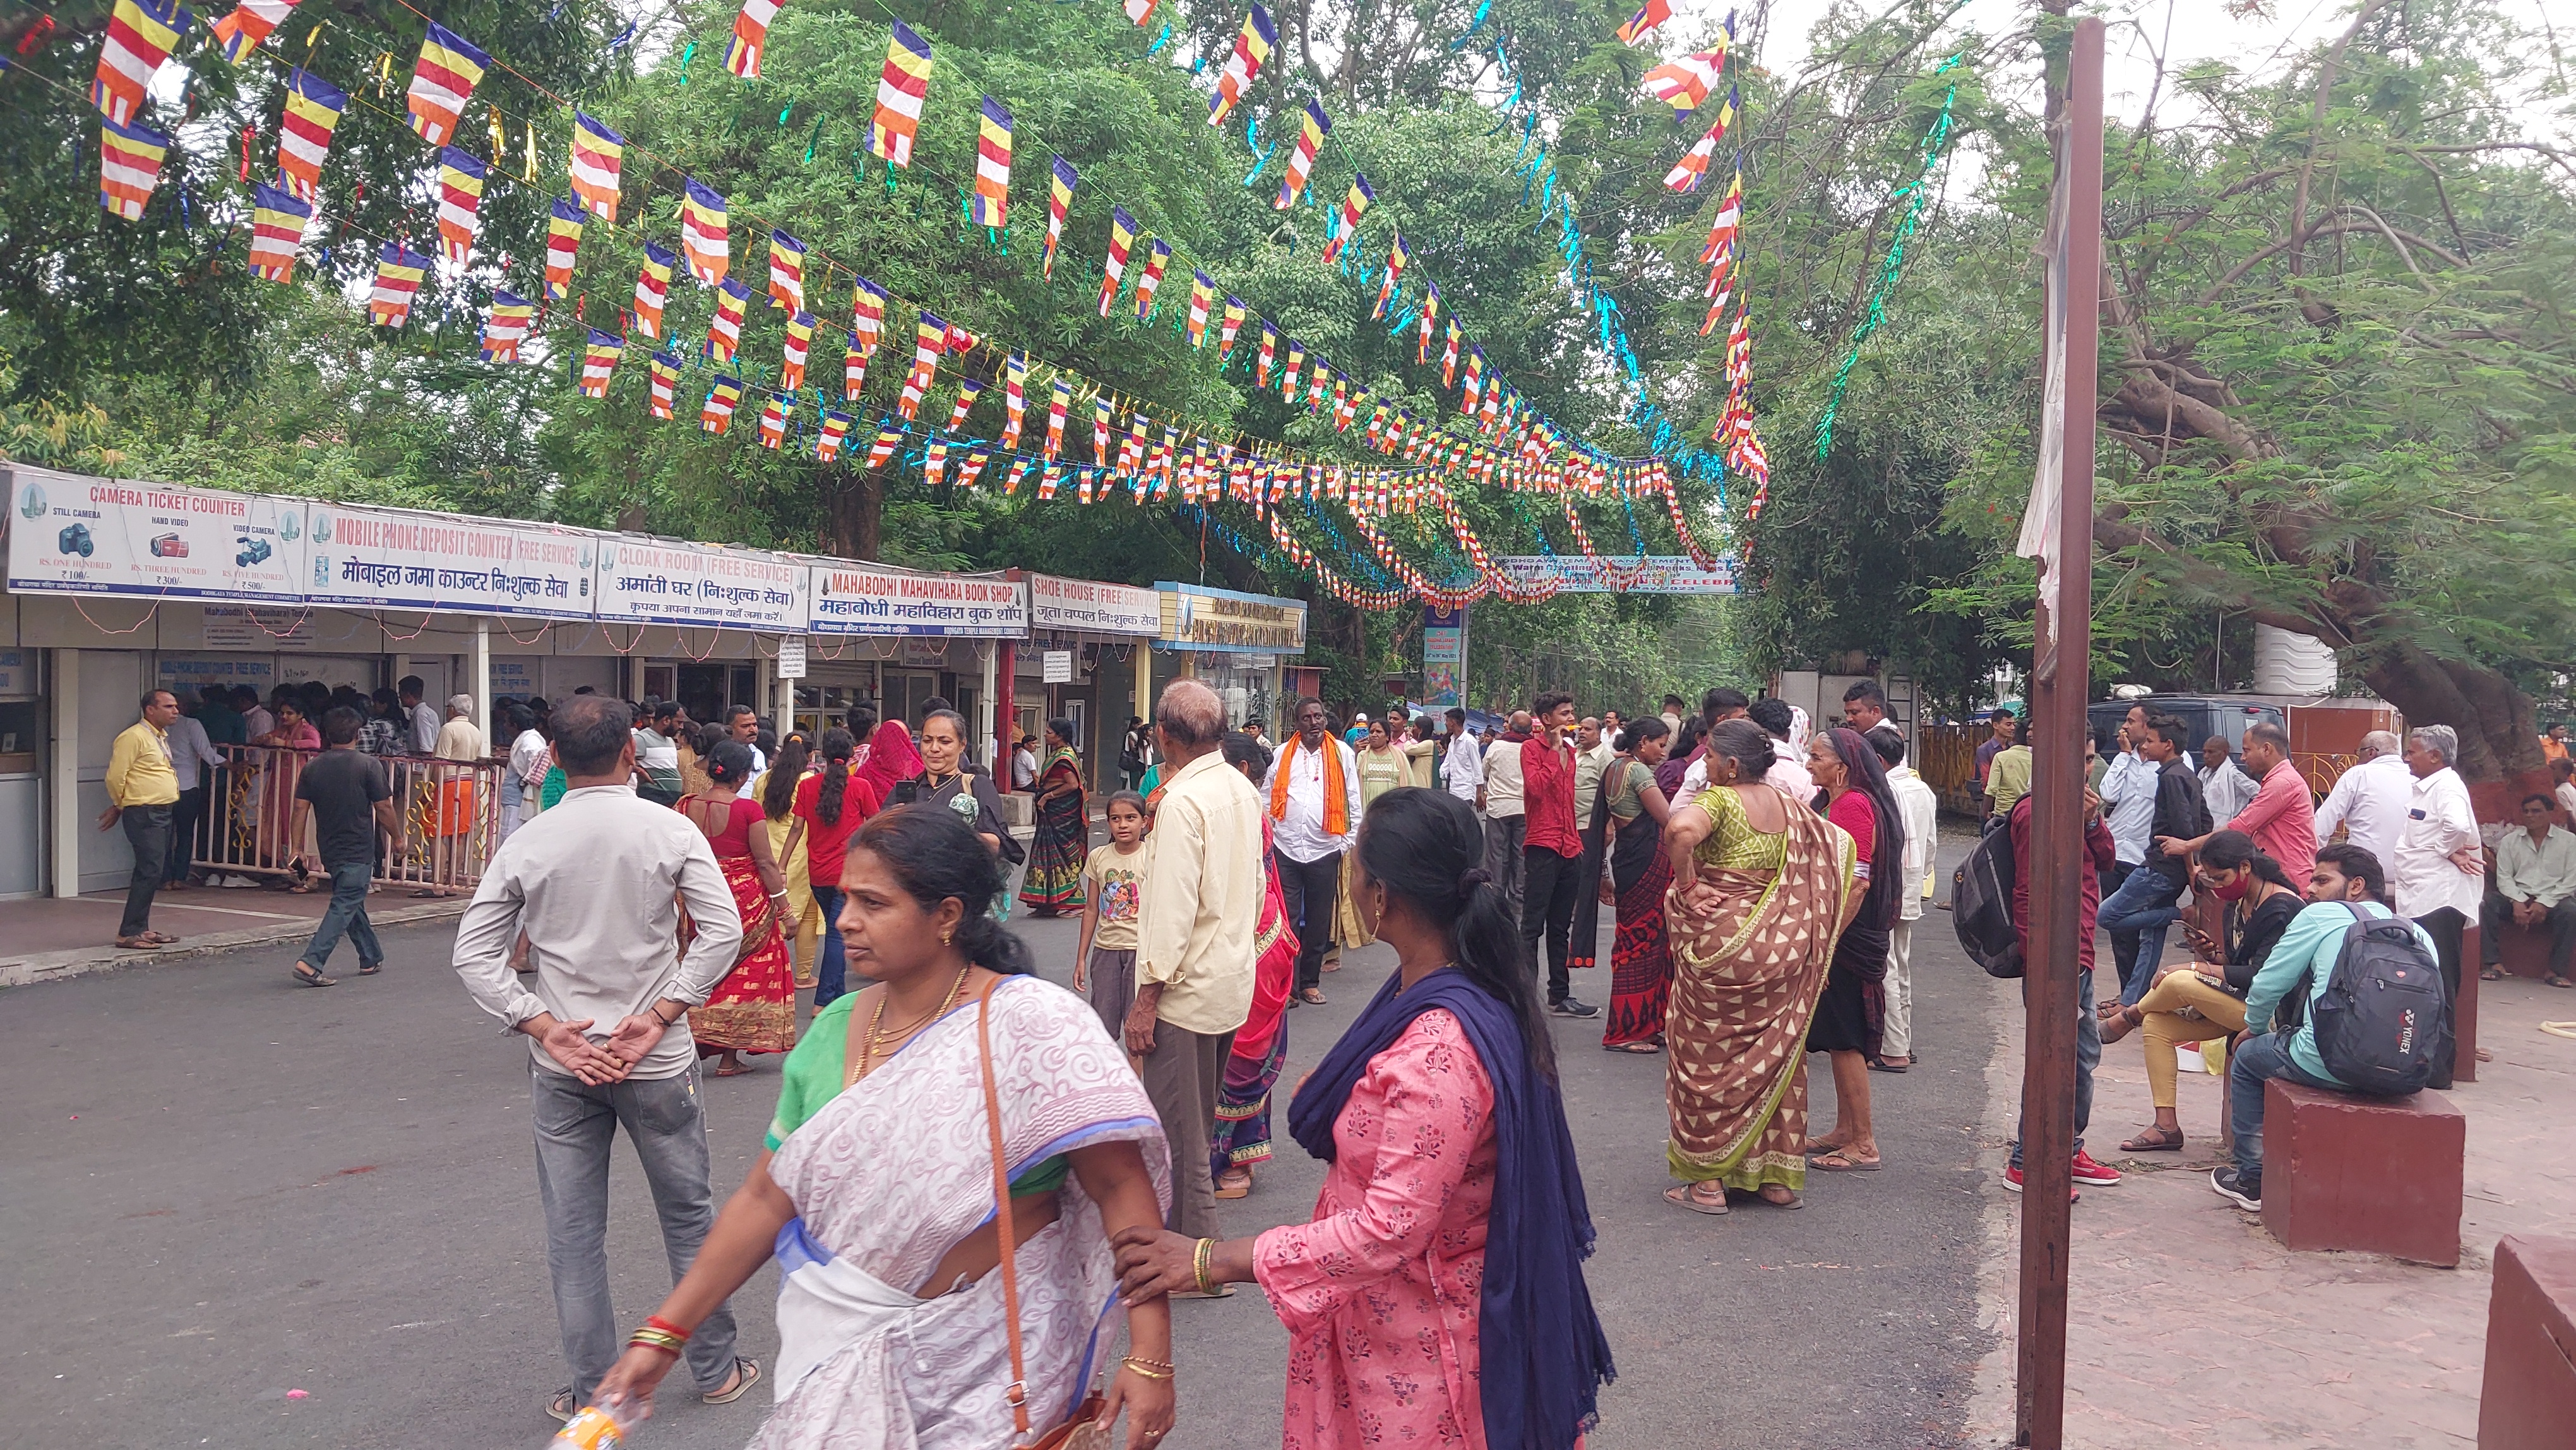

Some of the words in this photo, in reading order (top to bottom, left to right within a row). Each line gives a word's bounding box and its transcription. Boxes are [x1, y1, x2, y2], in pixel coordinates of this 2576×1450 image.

[90, 486, 143, 506] CAMERA
[147, 493, 189, 510] TICKET
[192, 498, 245, 517] COUNTER
[53, 507, 71, 517] STILL
[73, 509, 101, 518] CAMERA
[152, 516, 168, 525] HAND
[170, 518, 189, 527] VIDEO
[233, 524, 250, 532] VIDEO
[251, 526, 275, 536] CAMERA
[335, 517, 379, 548] MOBILE
[382, 522, 419, 551] PHONE
[420, 526, 465, 555] DEPOSIT
[467, 532, 513, 560] COUNTER
[516, 537, 539, 561] (FREE
[542, 542, 578, 566] SERVICE)
[54, 559, 69, 567] ONE
[73, 560, 112, 570] HUNDRED
[144, 565, 169, 573] THREE
[171, 566, 206, 575] HUNDRED
[619, 547, 661, 568] CLOAK
[665, 552, 703, 572] ROOM
[707, 556, 740, 576] (FREE
[744, 561, 794, 586] SERVICE)
[235, 570, 249, 578] FIVE
[252, 572, 284, 581] HUNDRED
[342, 556, 403, 588] मोबाइल
[404, 566, 435, 587] जमा
[438, 568, 489, 592] काउन्टर
[544, 573, 569, 599] सेवा
[671, 580, 693, 596] घर
[832, 573, 897, 596] MAHABODHI
[900, 578, 963, 601] MAHAVIHARA
[965, 583, 989, 602] BOOK
[991, 585, 1013, 603] SHOP
[1035, 577, 1061, 597] SHOE
[1064, 582, 1094, 602] HOUSE
[1097, 587, 1121, 606] (FREE
[205, 607, 243, 617] Mahabodhi
[630, 602, 660, 614] कृपया
[662, 604, 691, 614] अपना
[693, 606, 723, 617] सामान
[725, 608, 743, 618] यहाँ
[744, 611, 762, 620] जमा
[819, 597, 891, 616] महाबोधी
[893, 601, 965, 621] महाविहारा
[968, 607, 994, 625] बुक
[997, 604, 1023, 621] शॉप
[1037, 604, 1061, 621] जूता
[1063, 608, 1096, 622] चप्पल
[1140, 613, 1158, 626] सेवा
[2399, 1027, 2413, 1055] YONEX
